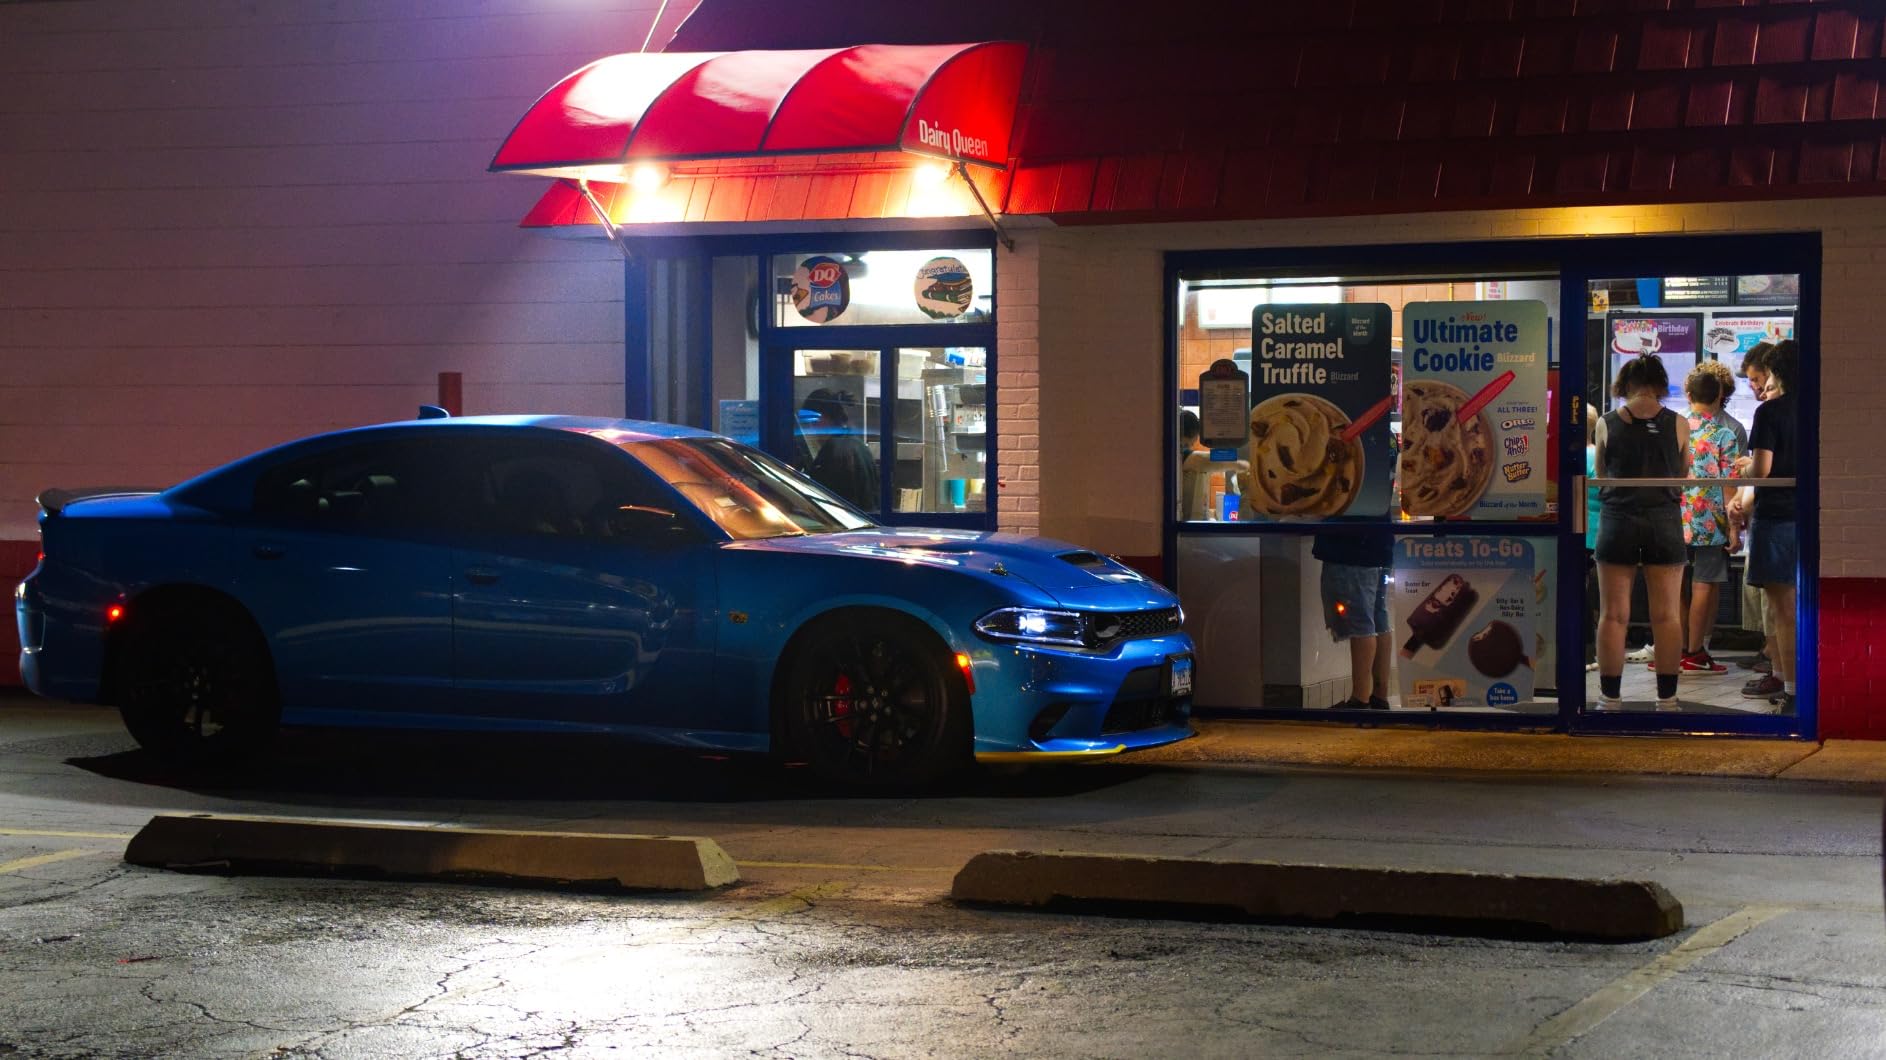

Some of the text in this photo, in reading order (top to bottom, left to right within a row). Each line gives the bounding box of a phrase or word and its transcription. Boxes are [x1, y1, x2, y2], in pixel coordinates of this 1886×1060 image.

[919, 120, 988, 157] Dairy Queen
[814, 270, 836, 282] DQ
[814, 291, 840, 303] Cakes
[1262, 312, 1325, 334] Salted
[1657, 324, 1689, 334] Birthday
[1414, 316, 1518, 344] Ultimate
[1261, 338, 1344, 359] Caramel
[1413, 345, 1536, 372] Cookie Blizzard
[1260, 362, 1359, 384] Truffle Blizzard
[1502, 419, 1535, 430] OREO
[1504, 436, 1524, 449] Chips
[1503, 462, 1527, 474] Nutter
[1507, 468, 1531, 481] Butter
[1479, 500, 1503, 508] Blizzard
[1404, 539, 1523, 558] Treats To-Go
